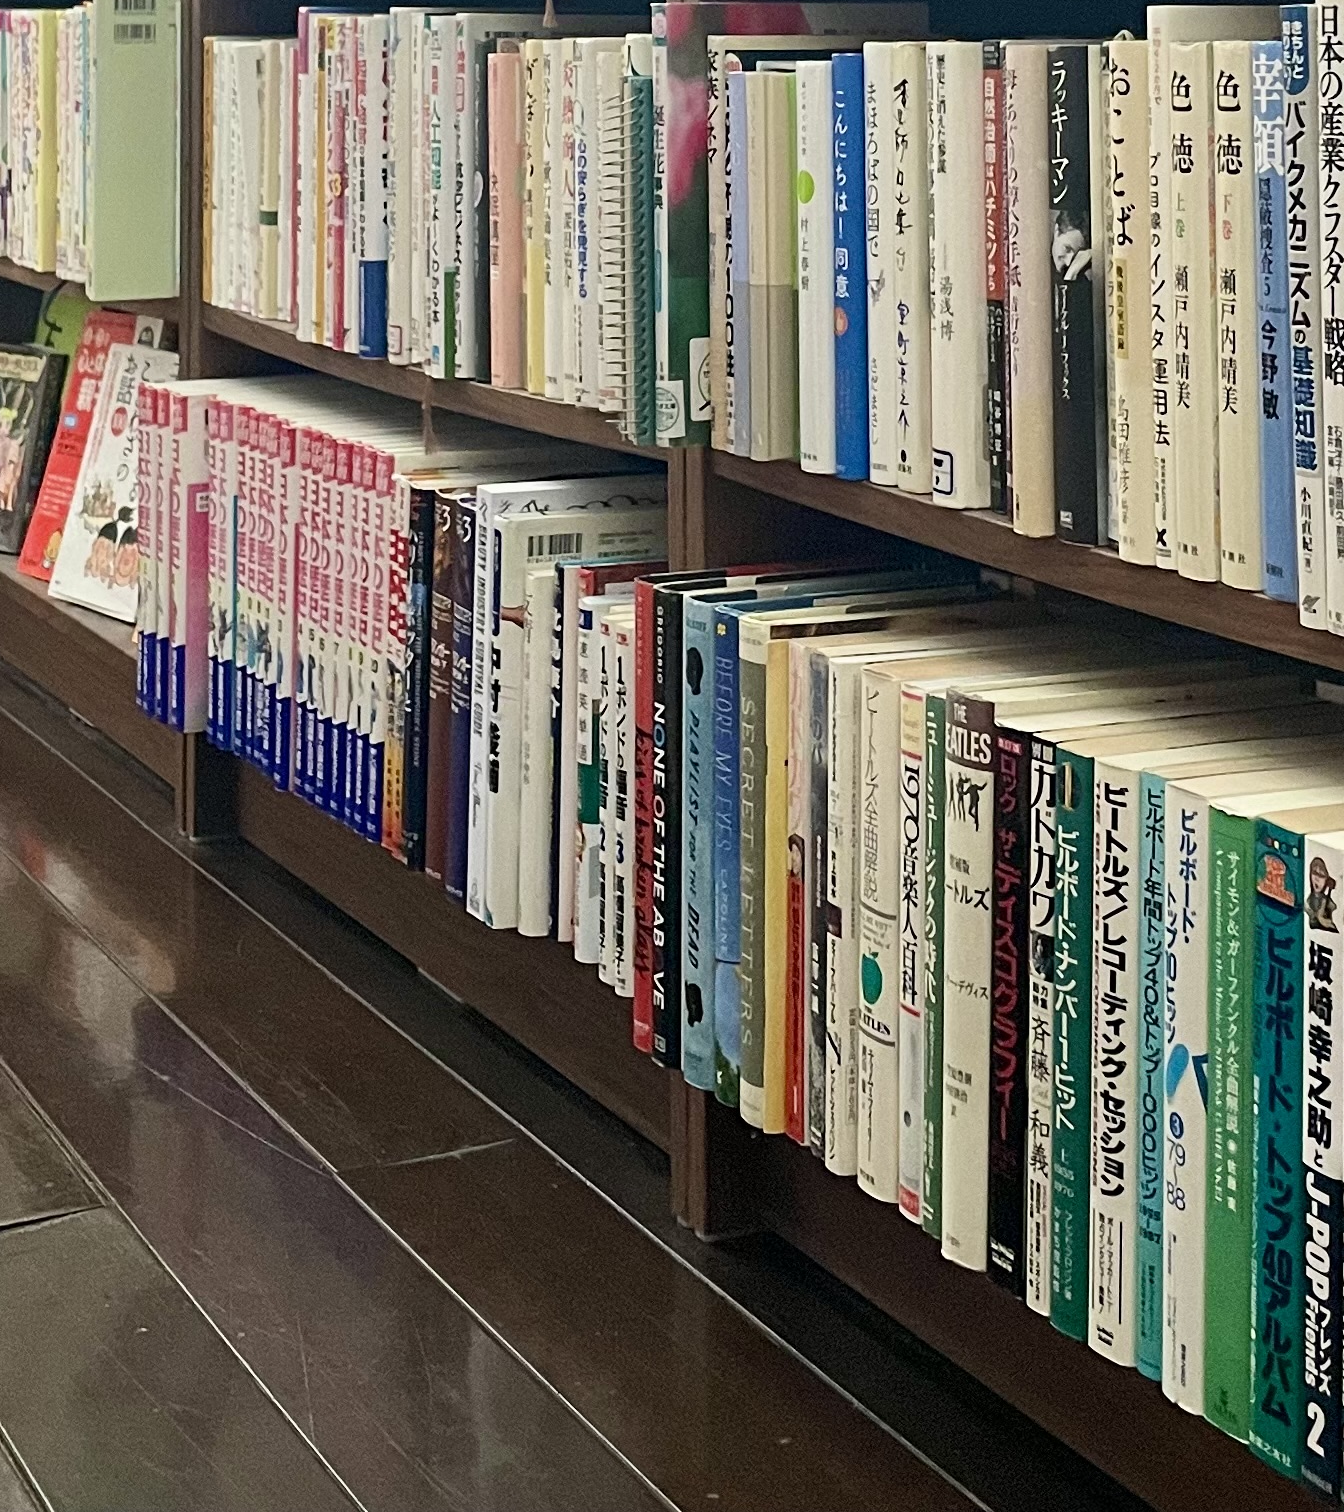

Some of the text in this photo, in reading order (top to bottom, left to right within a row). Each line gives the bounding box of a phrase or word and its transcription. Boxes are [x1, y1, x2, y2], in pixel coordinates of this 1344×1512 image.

[1051, 60, 1070, 205] ラッキーマン
[1170, 69, 1194, 175] 色徳
[1215, 69, 1244, 176] 色徳
[1174, 265, 1192, 410] 瀬戸内晴美
[1219, 265, 1239, 415] 瀬戸内晴美
[1285, 100, 1319, 472] バイクメカニズムの基礎知識
[472, 524, 489, 738] BEAUTY INDUSTRY SURVIVAL GUIDE
[715, 654, 734, 740] BEFORE
[953, 702, 968, 725] THE
[688, 709, 701, 827] PLAYLIST
[714, 795, 734, 852] EYES
[715, 749, 733, 786] MY
[651, 700, 667, 1011] NONE OF THE ABVE
[688, 866, 697, 896] THE
[739, 695, 756, 1048] SECRET LETTERS
[1030, 764, 1057, 929] カドカワ
[686, 900, 701, 970] DEAD
[1307, 940, 1334, 1172] 坂崎幸之助と
[1307, 1401, 1325, 1459] 2
